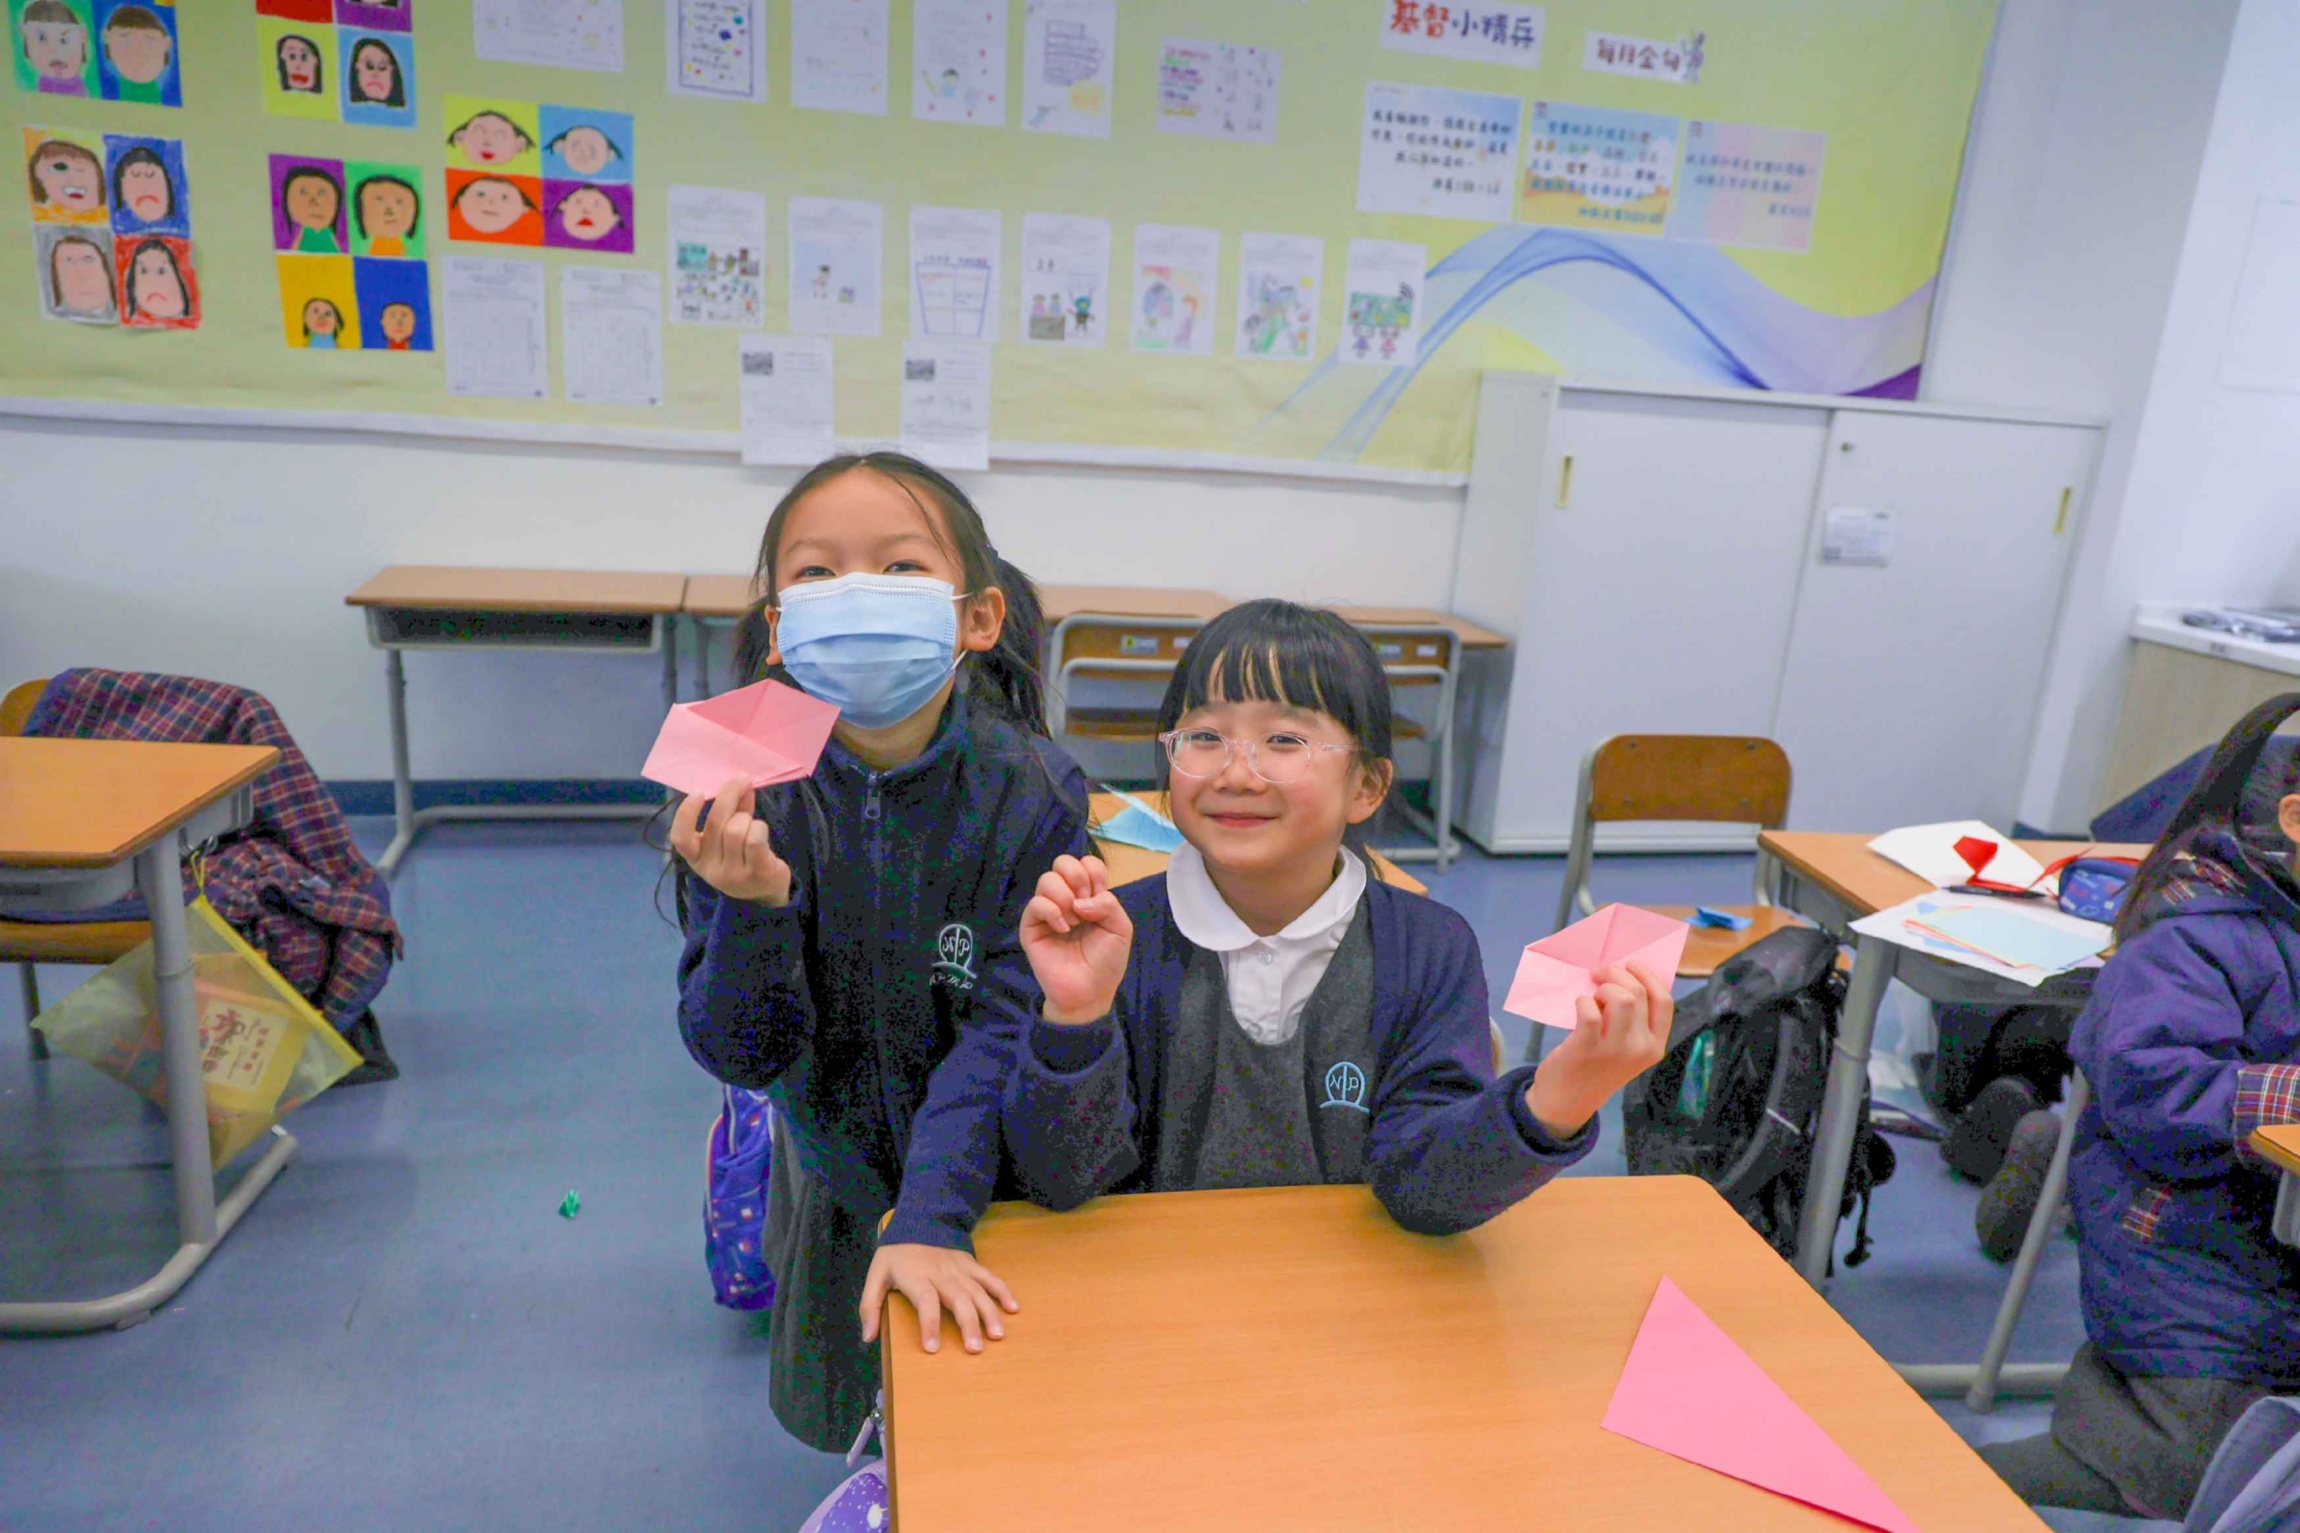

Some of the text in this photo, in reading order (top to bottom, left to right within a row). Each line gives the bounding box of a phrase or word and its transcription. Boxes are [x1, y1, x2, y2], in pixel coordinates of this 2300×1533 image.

[1390, 0, 1534, 48] 基督小精兵
